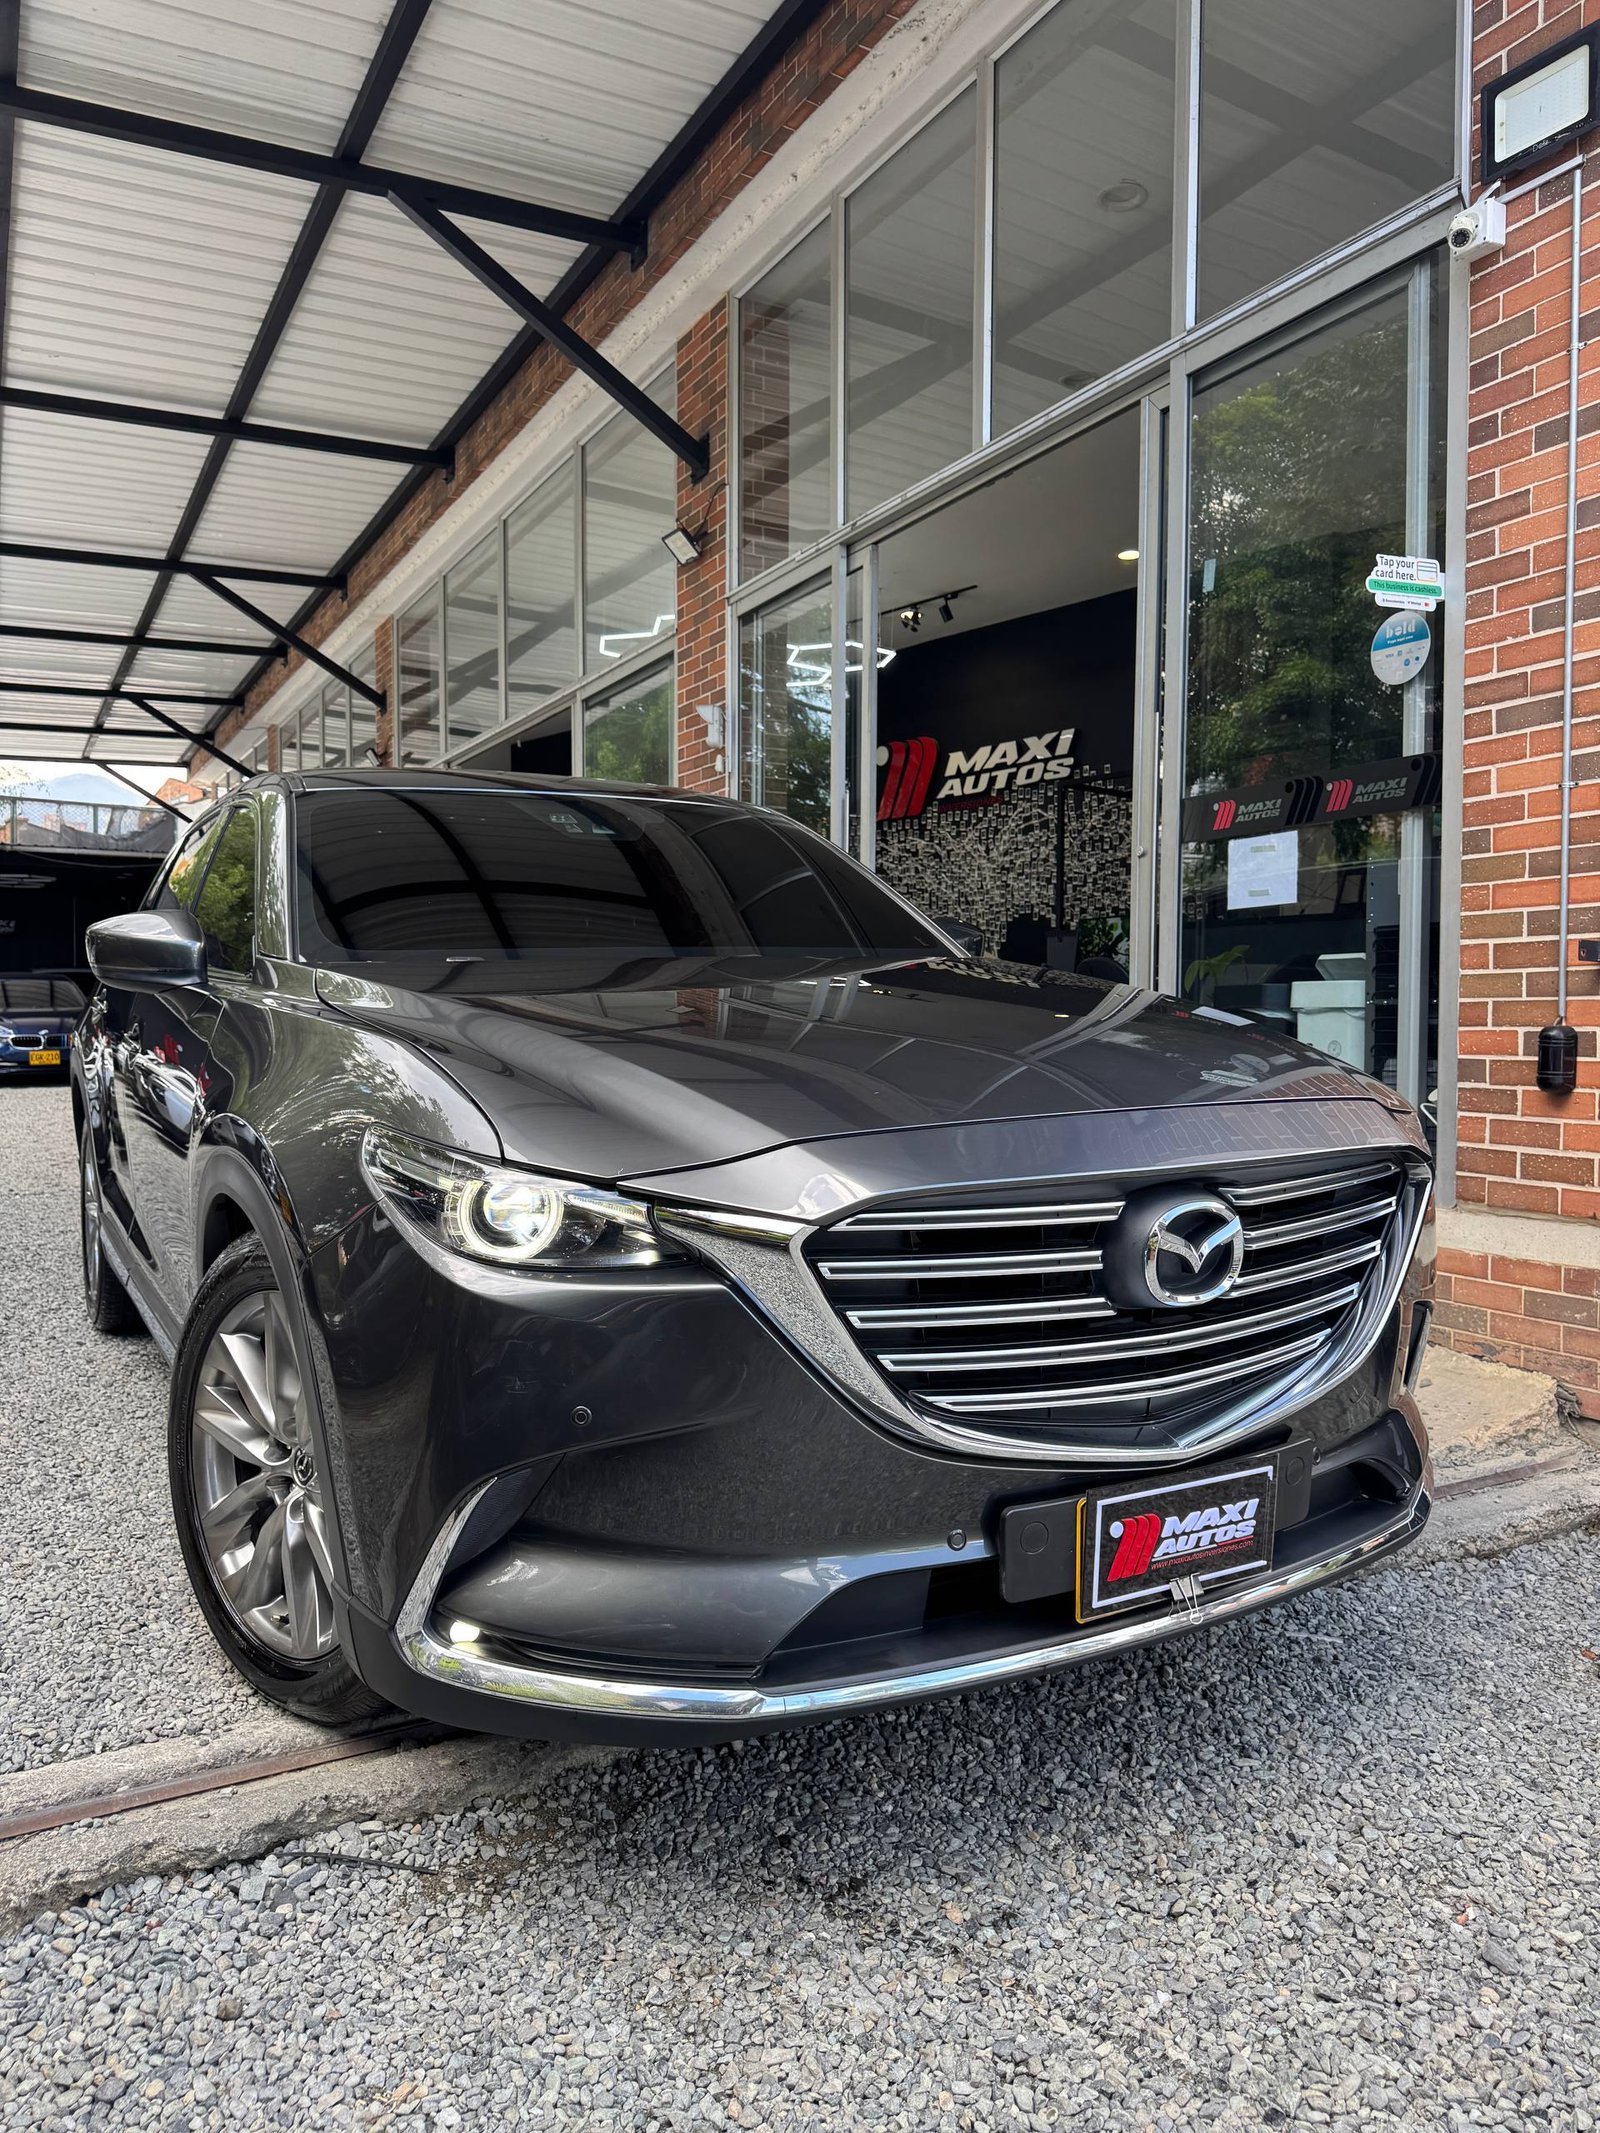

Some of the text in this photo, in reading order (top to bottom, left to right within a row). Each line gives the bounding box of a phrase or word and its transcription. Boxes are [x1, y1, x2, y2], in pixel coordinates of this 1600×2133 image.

[1379, 556, 1415, 569] Tap your
[1375, 569, 1417, 581] card here.
[1373, 581, 1385, 589] This
[1386, 583, 1409, 592] business
[1386, 619, 1416, 639] bold
[944, 728, 1075, 777] MAXI
[936, 757, 1074, 799] AUTOS
[1355, 777, 1408, 795] MAXI
[1352, 788, 1407, 804] AUTOS
[1235, 808, 1281, 823] AUTOS
[1238, 798, 1282, 815] MAXI
[1161, 1498, 1259, 1538] MAXI
[1153, 1519, 1257, 1557] AUTOS
[1151, 1540, 1254, 1570] www.maxiautosinversiones.com
